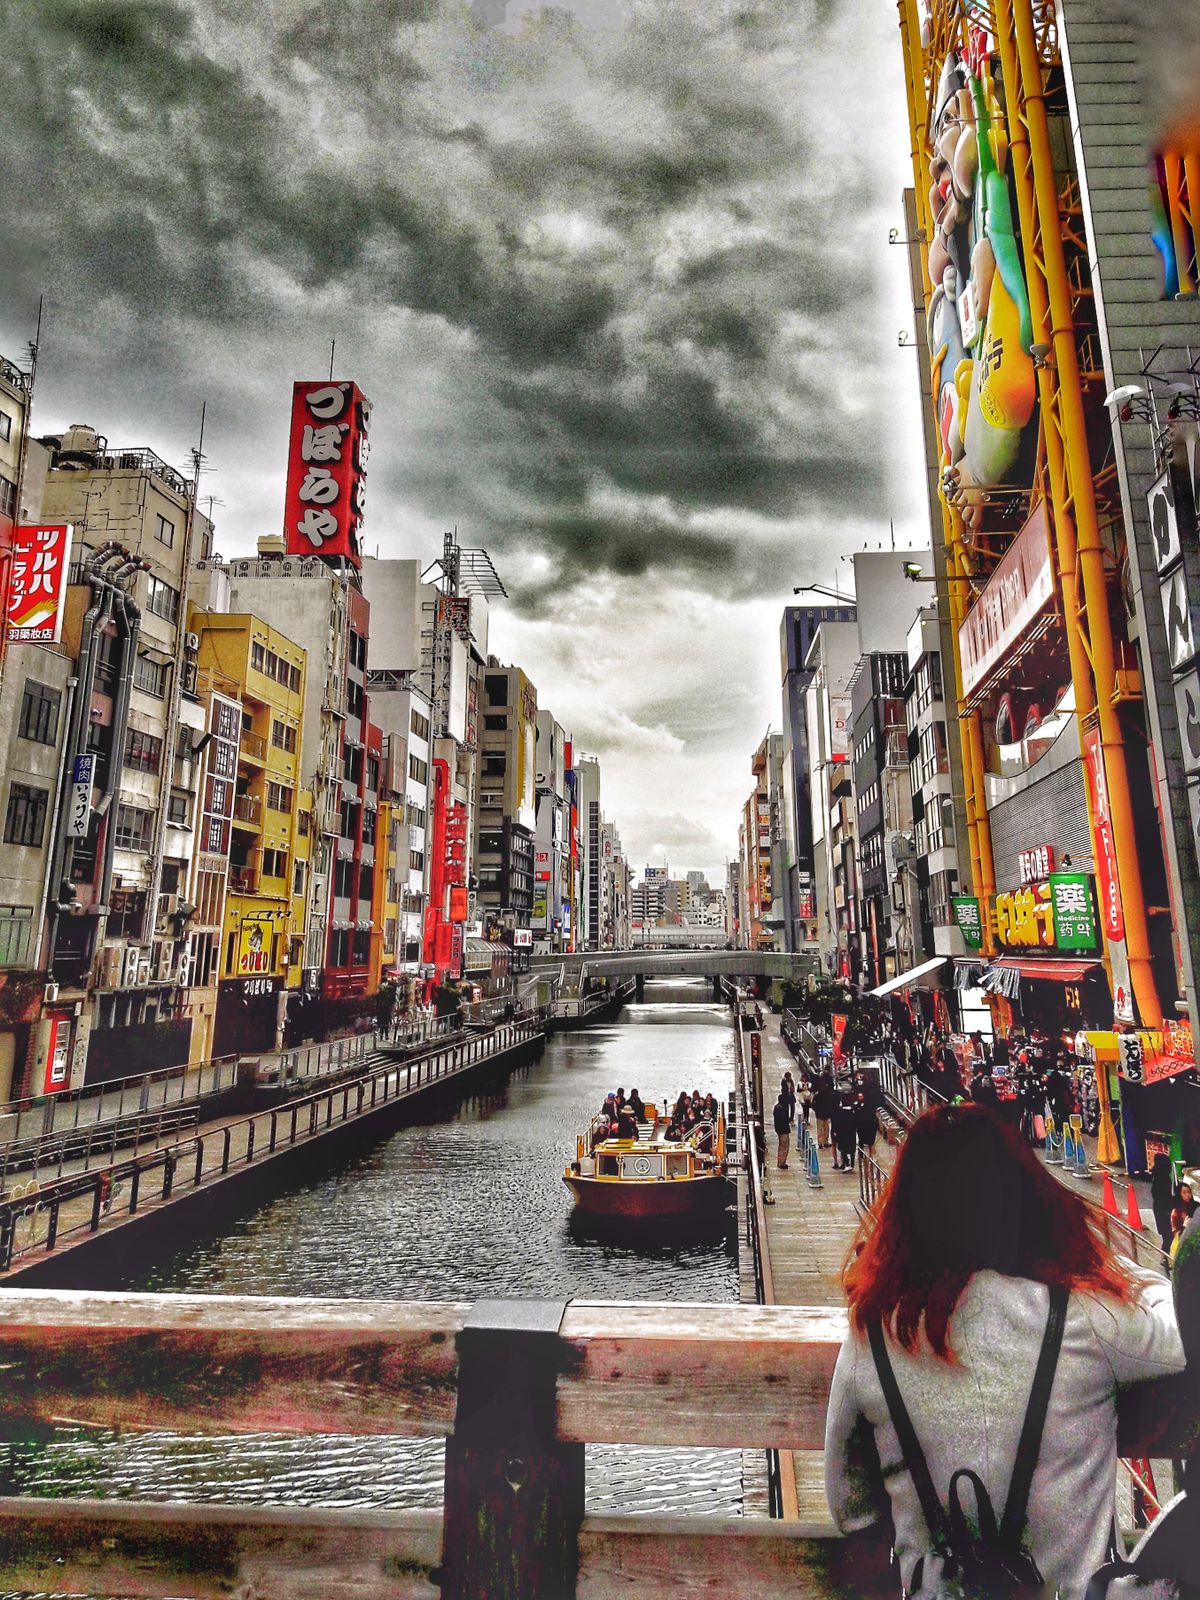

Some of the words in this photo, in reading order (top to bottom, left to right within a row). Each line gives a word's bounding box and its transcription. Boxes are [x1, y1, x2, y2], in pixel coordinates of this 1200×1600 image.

[297, 383, 350, 547] づぼらや
[29, 531, 59, 594] ツルハ
[73, 784, 89, 834] いろりや
[956, 904, 979, 925] 薬
[1054, 883, 1088, 914] 薬
[1060, 923, 1074, 937] 药
[1076, 923, 1091, 937] 약
